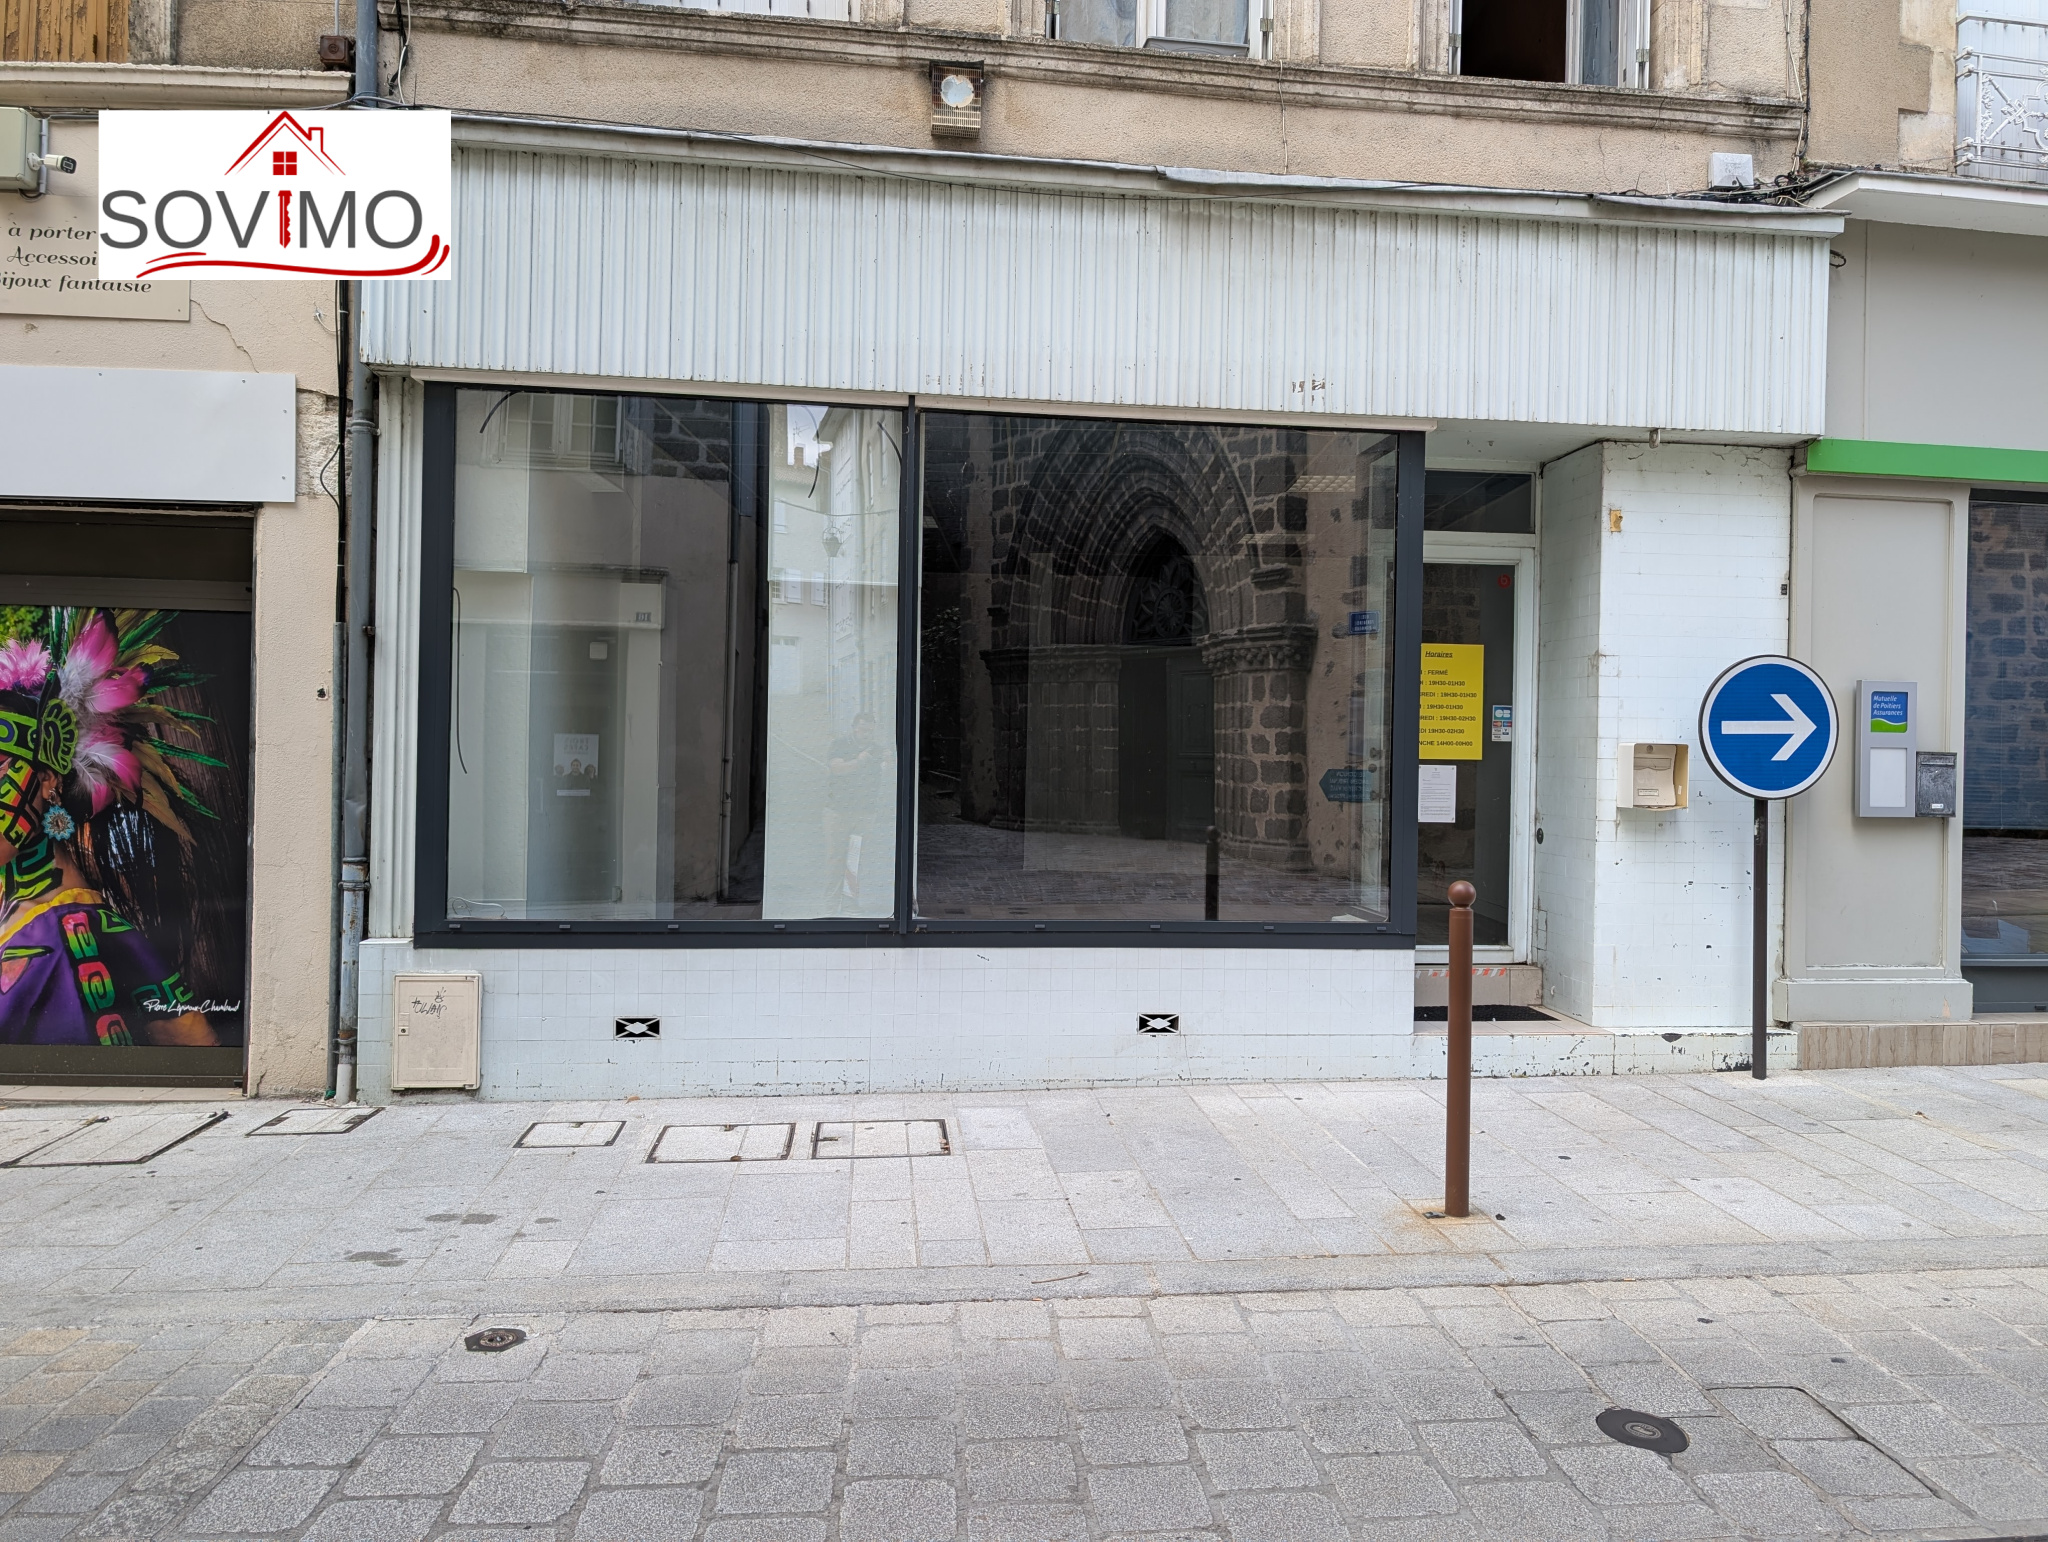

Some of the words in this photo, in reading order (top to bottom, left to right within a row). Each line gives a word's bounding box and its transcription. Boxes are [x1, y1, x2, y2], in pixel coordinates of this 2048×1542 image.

[8, 222, 21, 237] à
[29, 226, 97, 241] porter
[0, 271, 52, 290] ijoux
[59, 275, 152, 293] fantaisie
[1425, 650, 1453, 658] Horaires
